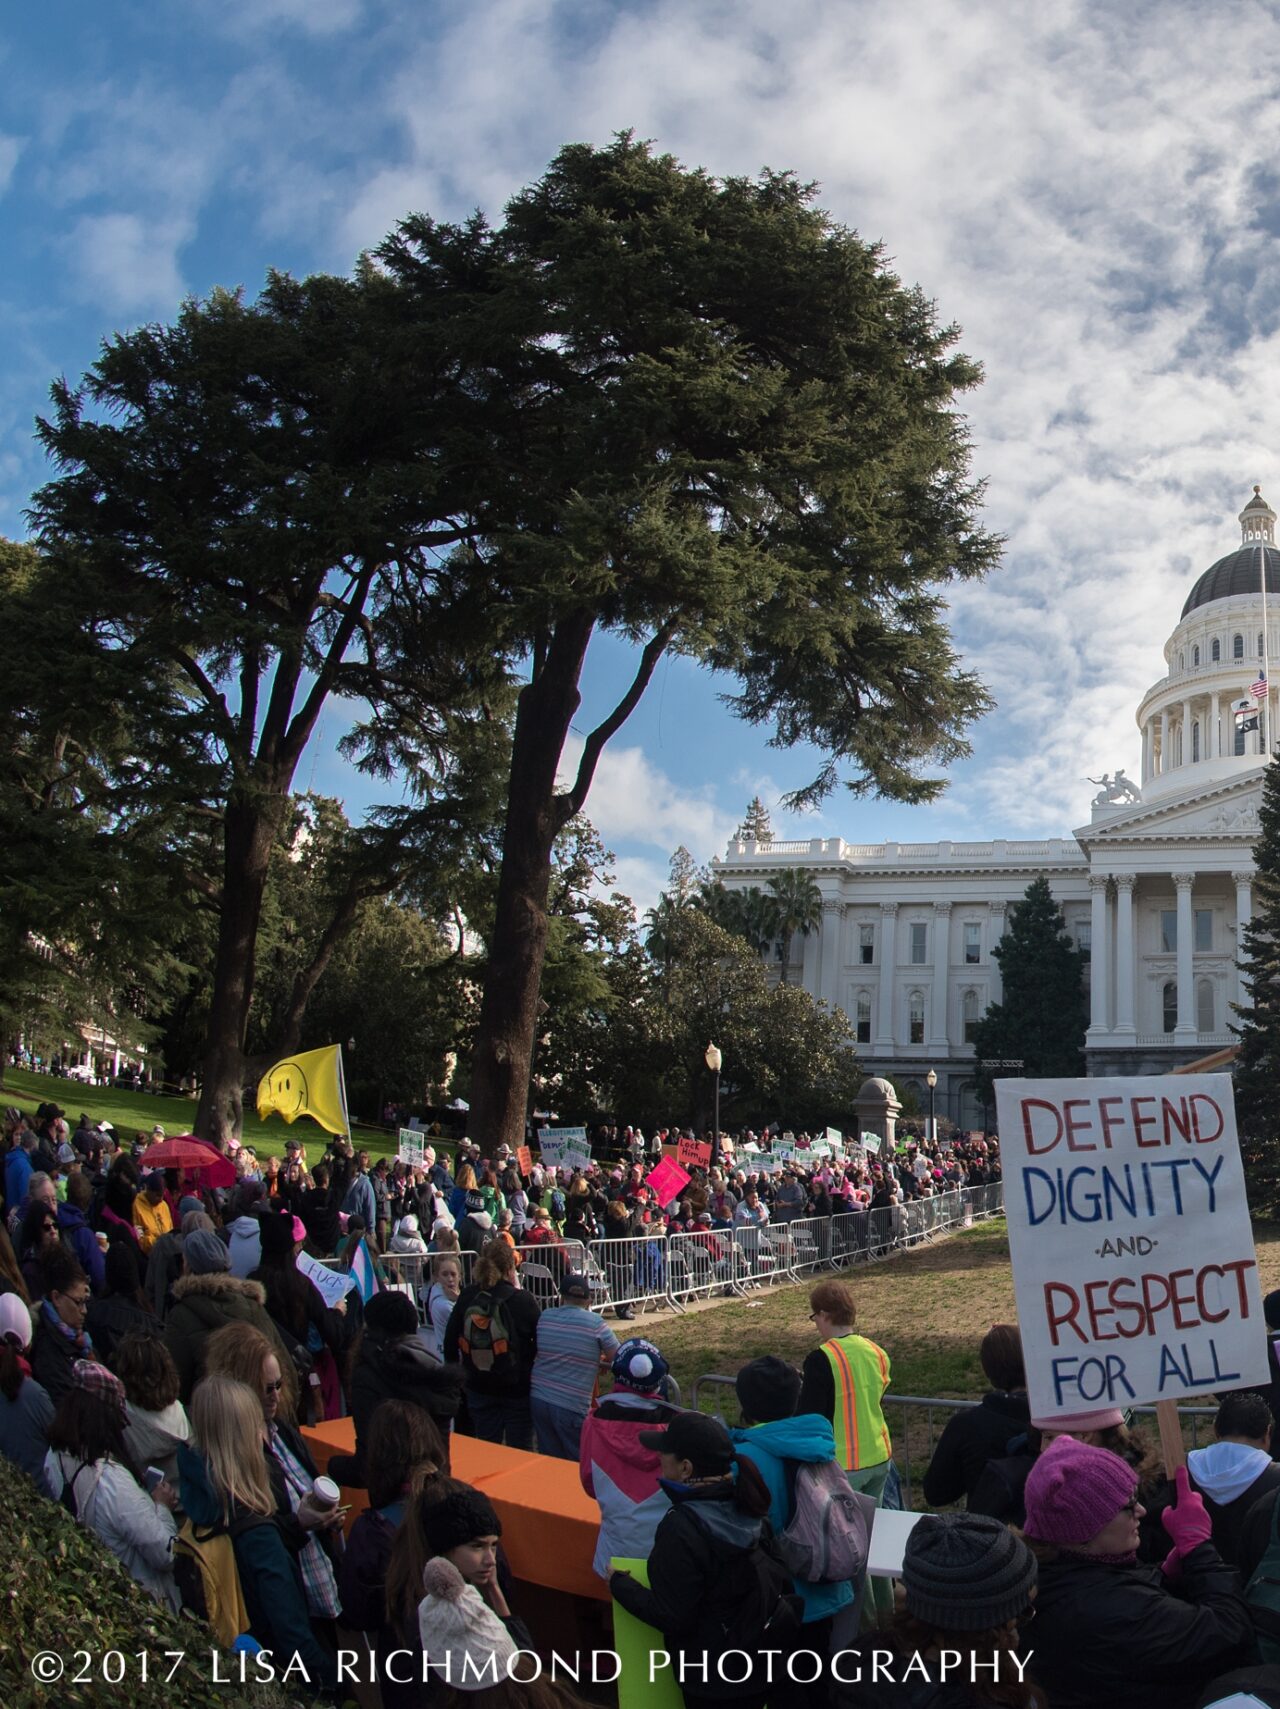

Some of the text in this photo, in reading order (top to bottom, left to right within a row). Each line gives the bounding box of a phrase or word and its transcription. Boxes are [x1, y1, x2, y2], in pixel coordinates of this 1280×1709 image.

[679, 1139, 699, 1151] Lock
[682, 1147, 699, 1159] Him
[1020, 1094, 1225, 1156] DEFEND
[1022, 1154, 1225, 1226] DIGNITY
[307, 1263, 344, 1288] FUCK
[1043, 1259, 1257, 1346] RESPECT
[1052, 1339, 1241, 1406] FOR ALL
